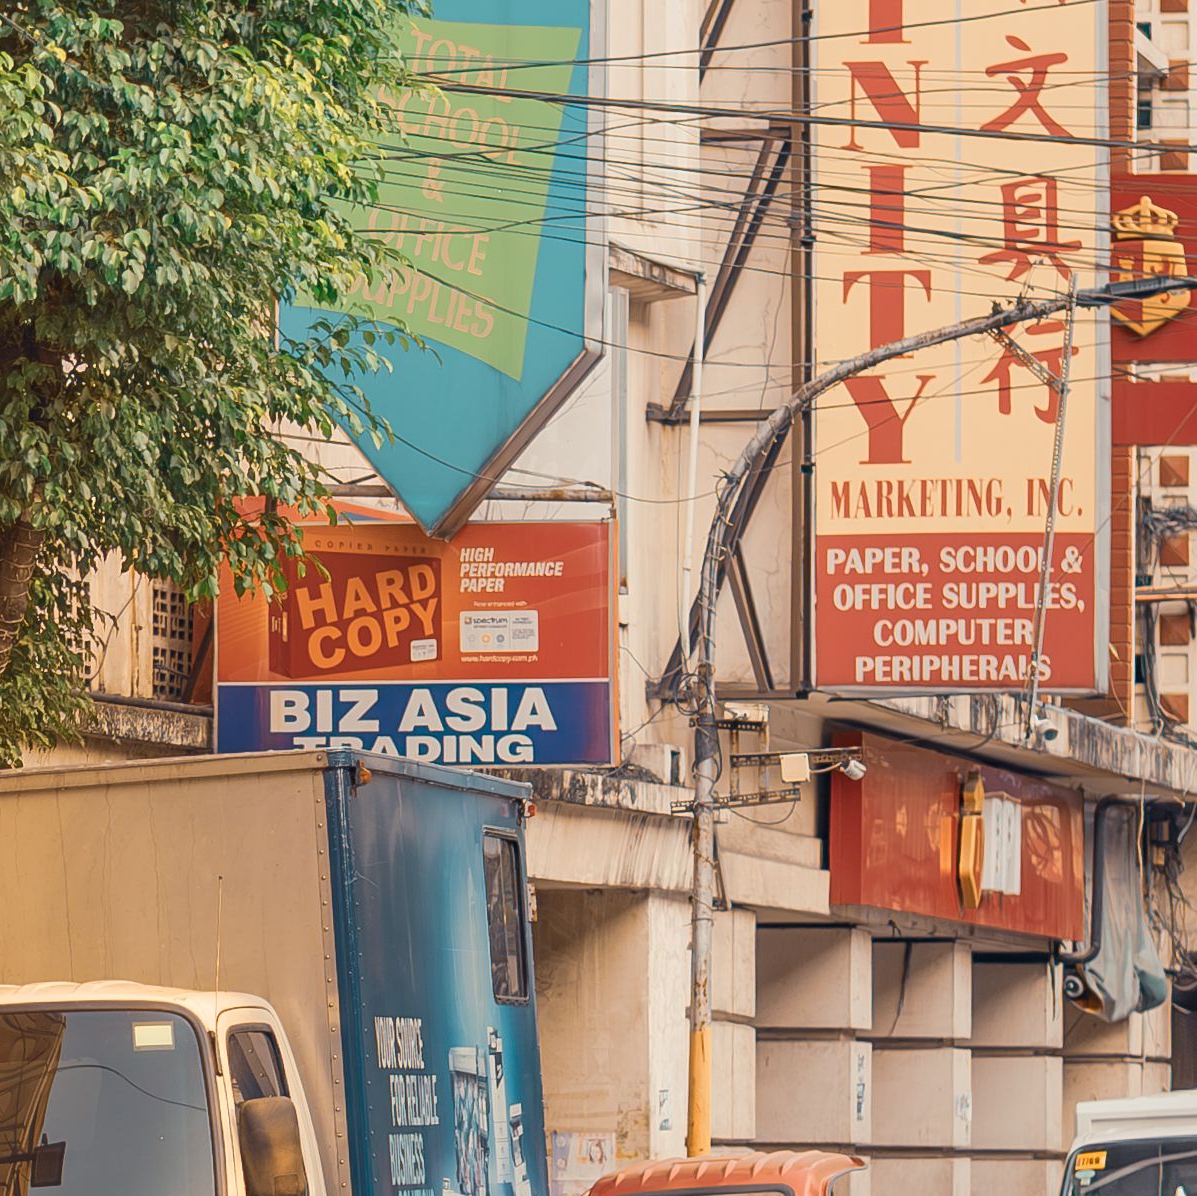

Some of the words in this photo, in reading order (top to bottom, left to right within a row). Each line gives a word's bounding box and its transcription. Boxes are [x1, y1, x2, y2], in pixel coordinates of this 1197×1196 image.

[410, 28, 513, 103] TOTAL
[421, 156, 444, 202] &
[978, 0, 1083, 424] 文具行
[368, 207, 491, 276] OFFICE
[348, 266, 494, 338] UPPLIES
[830, 478, 1012, 524] MARKETING,
[1026, 477, 1083, 517] INC.
[460, 547, 494, 562] HIGH
[460, 562, 564, 577] PERFORMANCE
[826, 547, 929, 577] PAPER,
[939, 546, 1054, 573] SCHOOL
[1061, 546, 1083, 573] &
[295, 563, 436, 630] HARD
[460, 578, 505, 592] PAPER
[833, 583, 932, 611] OFFICE
[942, 583, 1085, 613] SUPPLIES,
[308, 597, 438, 670] COPY
[873, 618, 1034, 647] COMPUTER
[855, 654, 1052, 682] PERIPHERALS
[270, 689, 379, 733] BIZ
[398, 687, 558, 733] ASIA
[374, 1016, 396, 1069] YOUR
[395, 1017, 425, 1070] SOURCE
[389, 1074, 407, 1126] FOR
[405, 1074, 439, 1126] RELIABLE
[389, 1132, 426, 1186] BUSINESS
